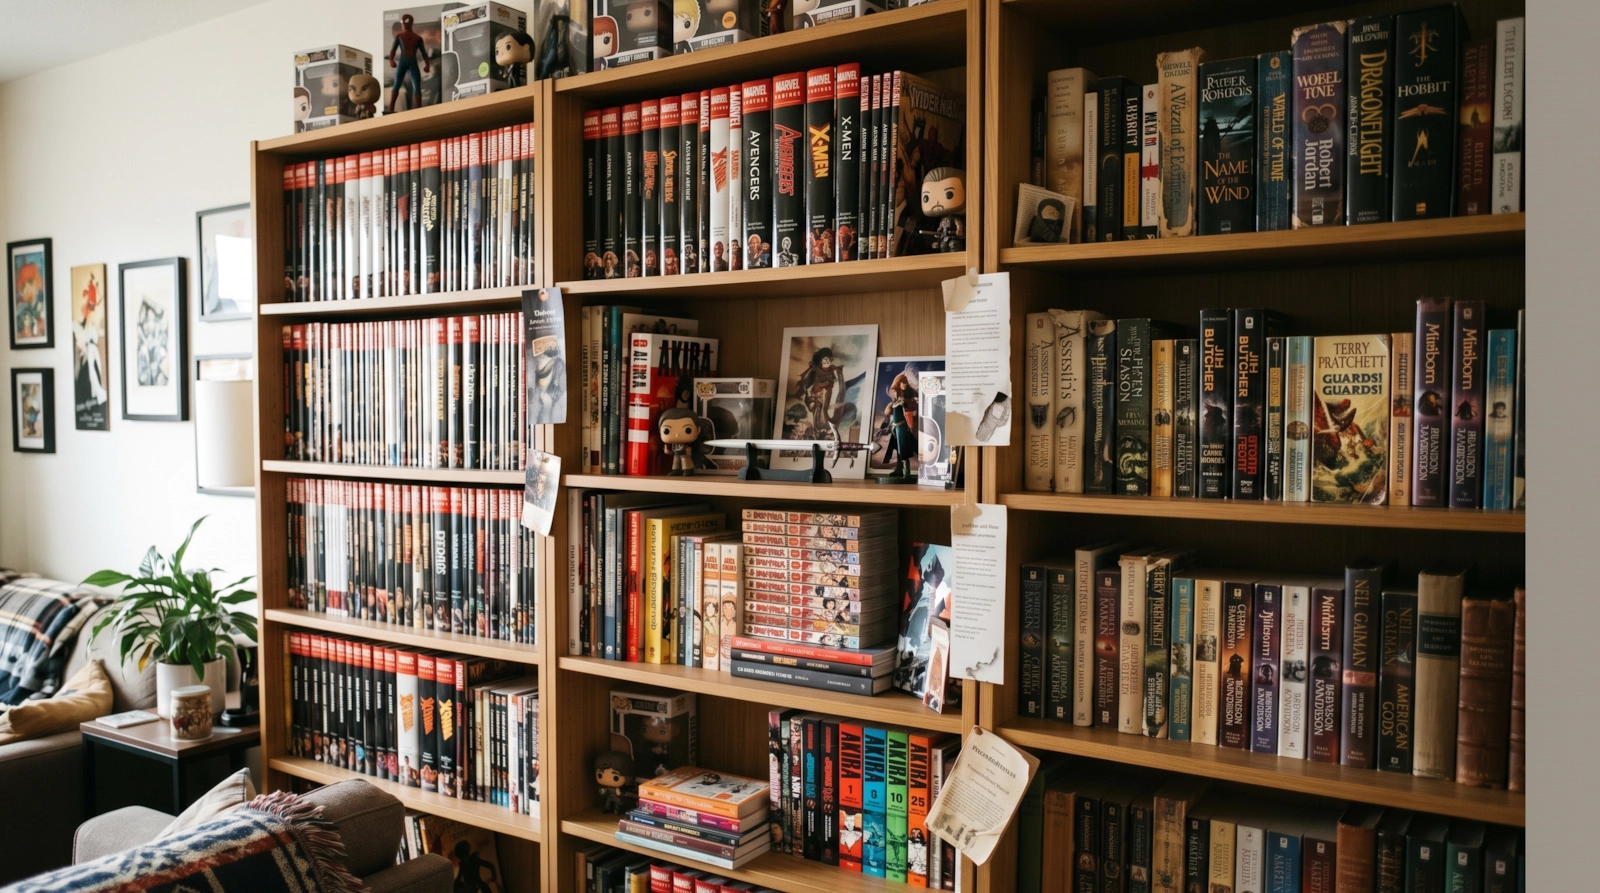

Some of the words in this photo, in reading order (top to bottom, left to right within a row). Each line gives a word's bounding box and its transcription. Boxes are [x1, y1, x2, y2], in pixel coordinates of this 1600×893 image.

[775, 78, 800, 92] MARVEL
[808, 73, 832, 87] MARVEL
[1398, 81, 1450, 97] HOBBIT
[743, 85, 767, 98] MARVEL
[1360, 50, 1387, 176] DRAGONFLIGHT
[841, 116, 852, 160] X-MEN
[749, 130, 761, 200] AVENGERS
[1217, 152, 1232, 160] THE
[1305, 138, 1319, 190] Jordan
[1319, 138, 1334, 189] Robert
[1204, 160, 1249, 179] NAME
[1227, 176, 1240, 184] THE
[1204, 186, 1250, 204] WIND
[1333, 341, 1370, 355] TERRY
[657, 339, 712, 378] AKIRA
[1204, 328, 1215, 392] BUTCHER
[1238, 335, 1249, 398] BUTCHER
[1318, 355, 1386, 369] PRATCHETT
[1322, 373, 1383, 385] GUARDS!
[1322, 384, 1383, 396] GUARDS!
[1381, 701, 1394, 736] GODS
[1396, 683, 1409, 749] AMERICAN
[841, 731, 861, 779] AKIRA
[864, 734, 885, 782] AKIRA
[888, 738, 907, 785] AKIRA
[910, 743, 928, 789] AKIRA
[848, 785, 853, 794] 1
[890, 792, 903, 803] 10
[911, 796, 925, 808] 25
